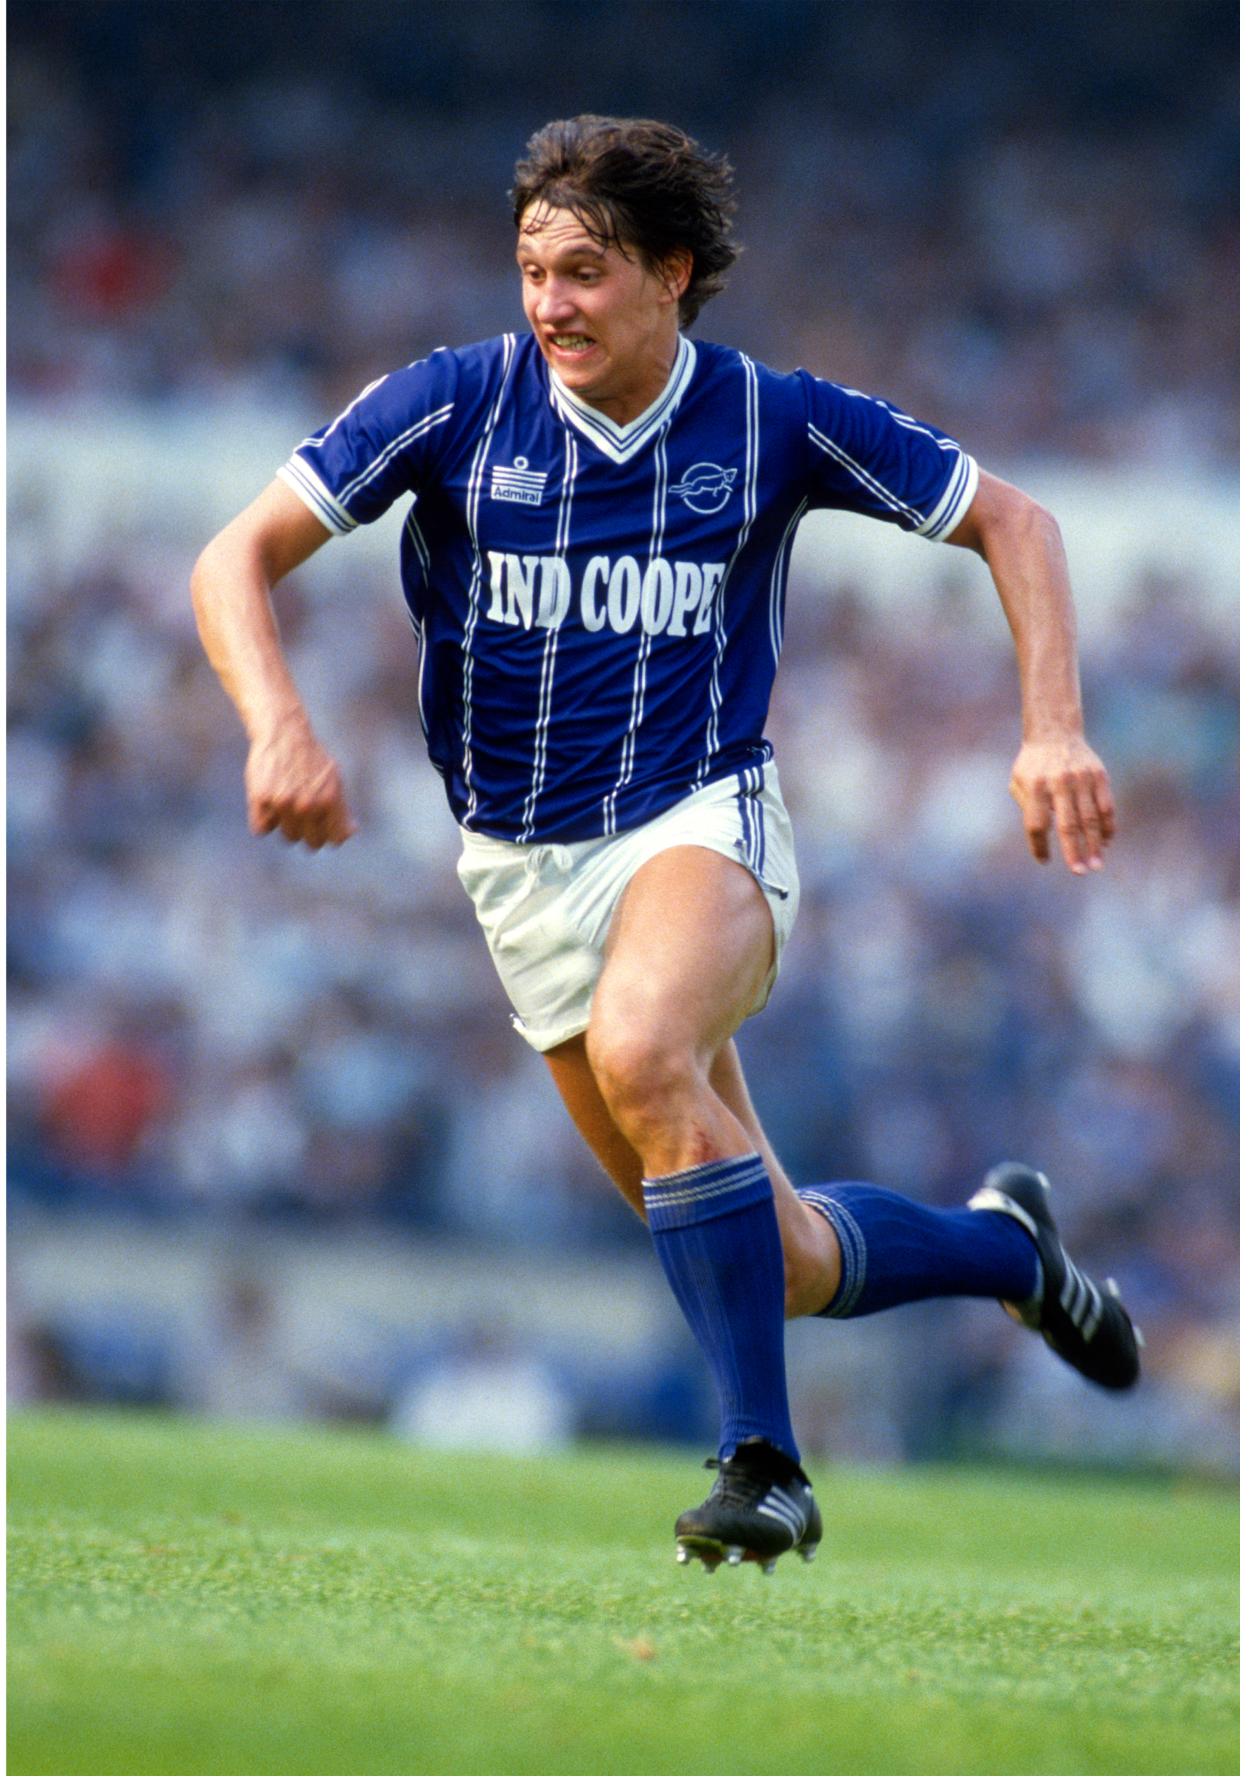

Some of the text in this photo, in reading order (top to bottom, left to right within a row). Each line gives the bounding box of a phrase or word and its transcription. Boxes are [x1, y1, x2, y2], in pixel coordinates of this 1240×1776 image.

[493, 485, 540, 503] Admiral
[487, 550, 726, 637] IND COOPE
